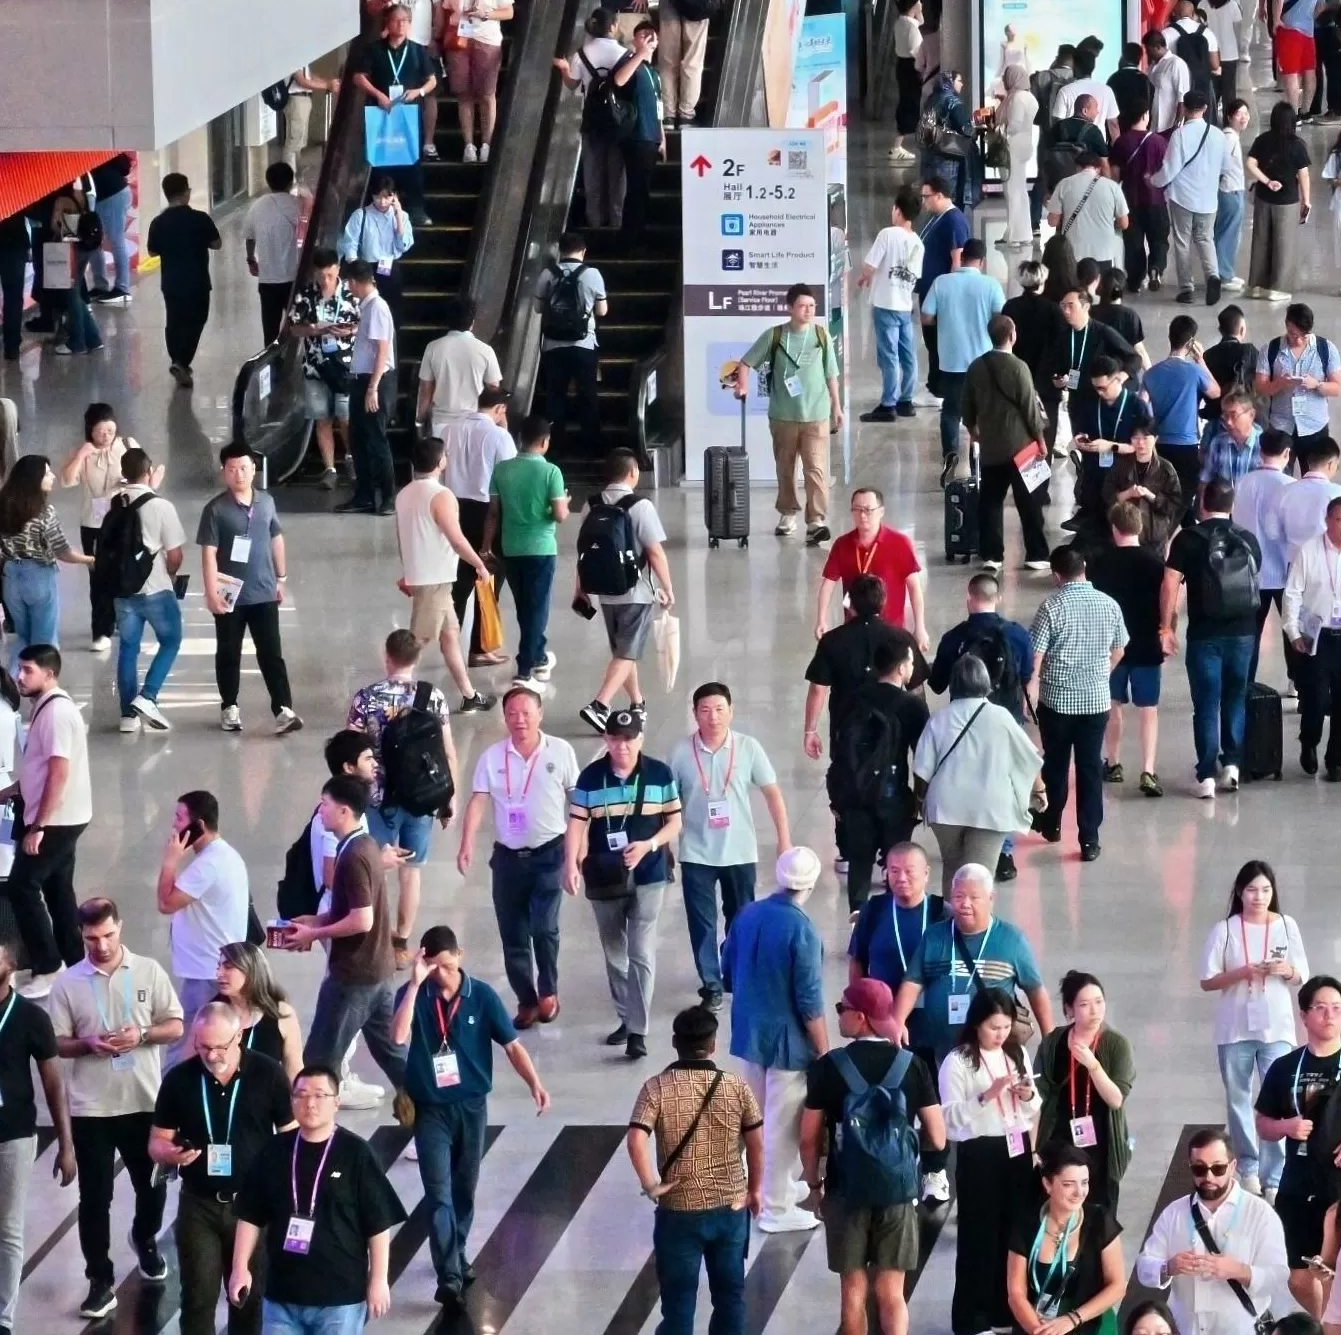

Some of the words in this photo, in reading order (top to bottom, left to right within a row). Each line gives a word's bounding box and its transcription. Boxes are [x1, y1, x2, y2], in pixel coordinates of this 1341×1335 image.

[722, 158, 745, 177] 2F
[723, 182, 743, 191] Hall
[745, 184, 795, 200] 1.2-5.2
[748, 251, 770, 259] Smart
[786, 251, 815, 259] Product
[708, 291, 732, 310] LF
